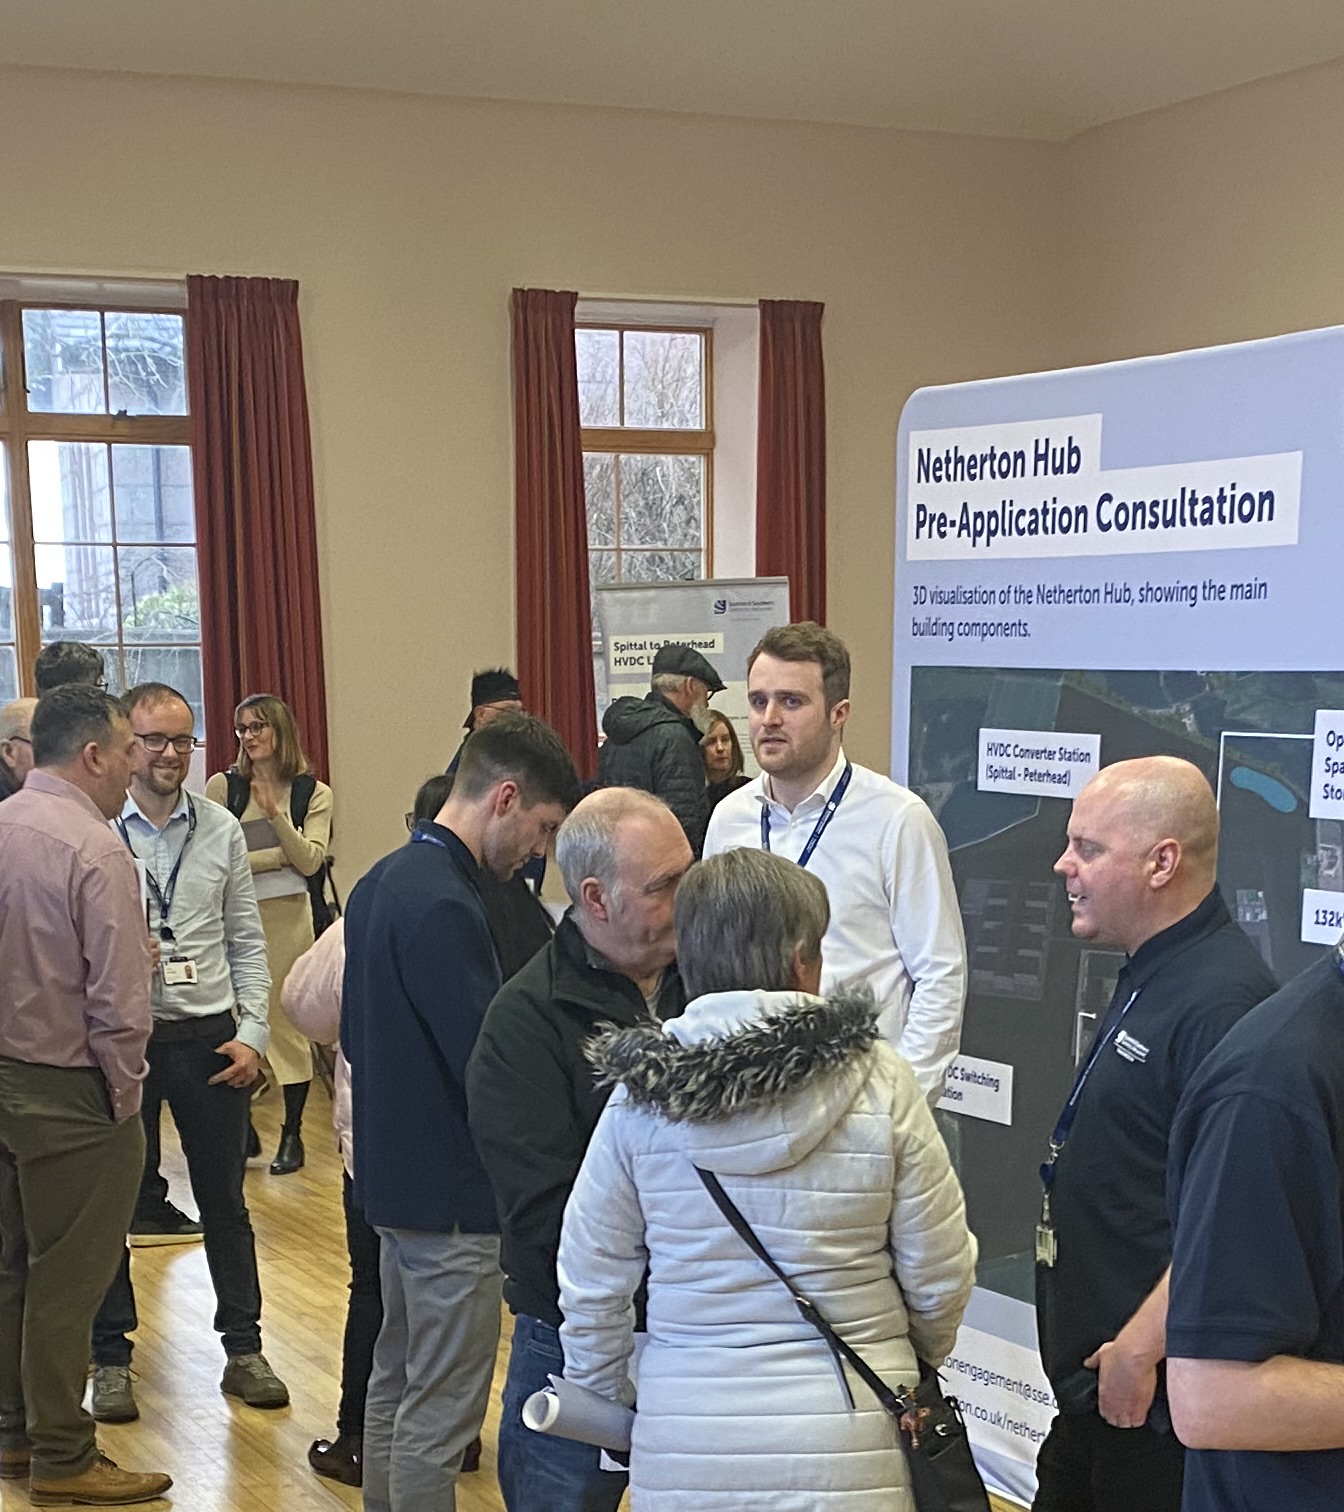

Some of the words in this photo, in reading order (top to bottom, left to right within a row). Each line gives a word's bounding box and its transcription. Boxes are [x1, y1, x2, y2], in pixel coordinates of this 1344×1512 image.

[916, 446, 1026, 484] Netherton
[1033, 436, 1082, 477] Hub
[915, 497, 1088, 548] Pre-Application
[1096, 482, 1275, 532] Consultation
[912, 585, 927, 605] 3D
[929, 584, 996, 605] visualisation
[999, 585, 1013, 605] of
[1013, 584, 1034, 605] the
[1036, 583, 1100, 605] Netherton
[1104, 582, 1134, 606] Hub,
[1138, 579, 1198, 607] showing
[1202, 578, 1226, 601] the
[1229, 577, 1268, 600] main
[911, 617, 955, 642] building
[957, 619, 1031, 642] components.
[613, 640, 648, 653] Spittal
[650, 642, 661, 650] to
[614, 656, 645, 666] HVDC
[986, 742, 1011, 758] HVDC
[1013, 744, 1056, 762] Converter
[1058, 747, 1091, 764] Station
[985, 765, 1016, 784] (Spittal
[1023, 767, 1071, 787] Peterhead)
[947, 1065, 958, 1079] DC
[960, 1068, 1000, 1092] Switching
